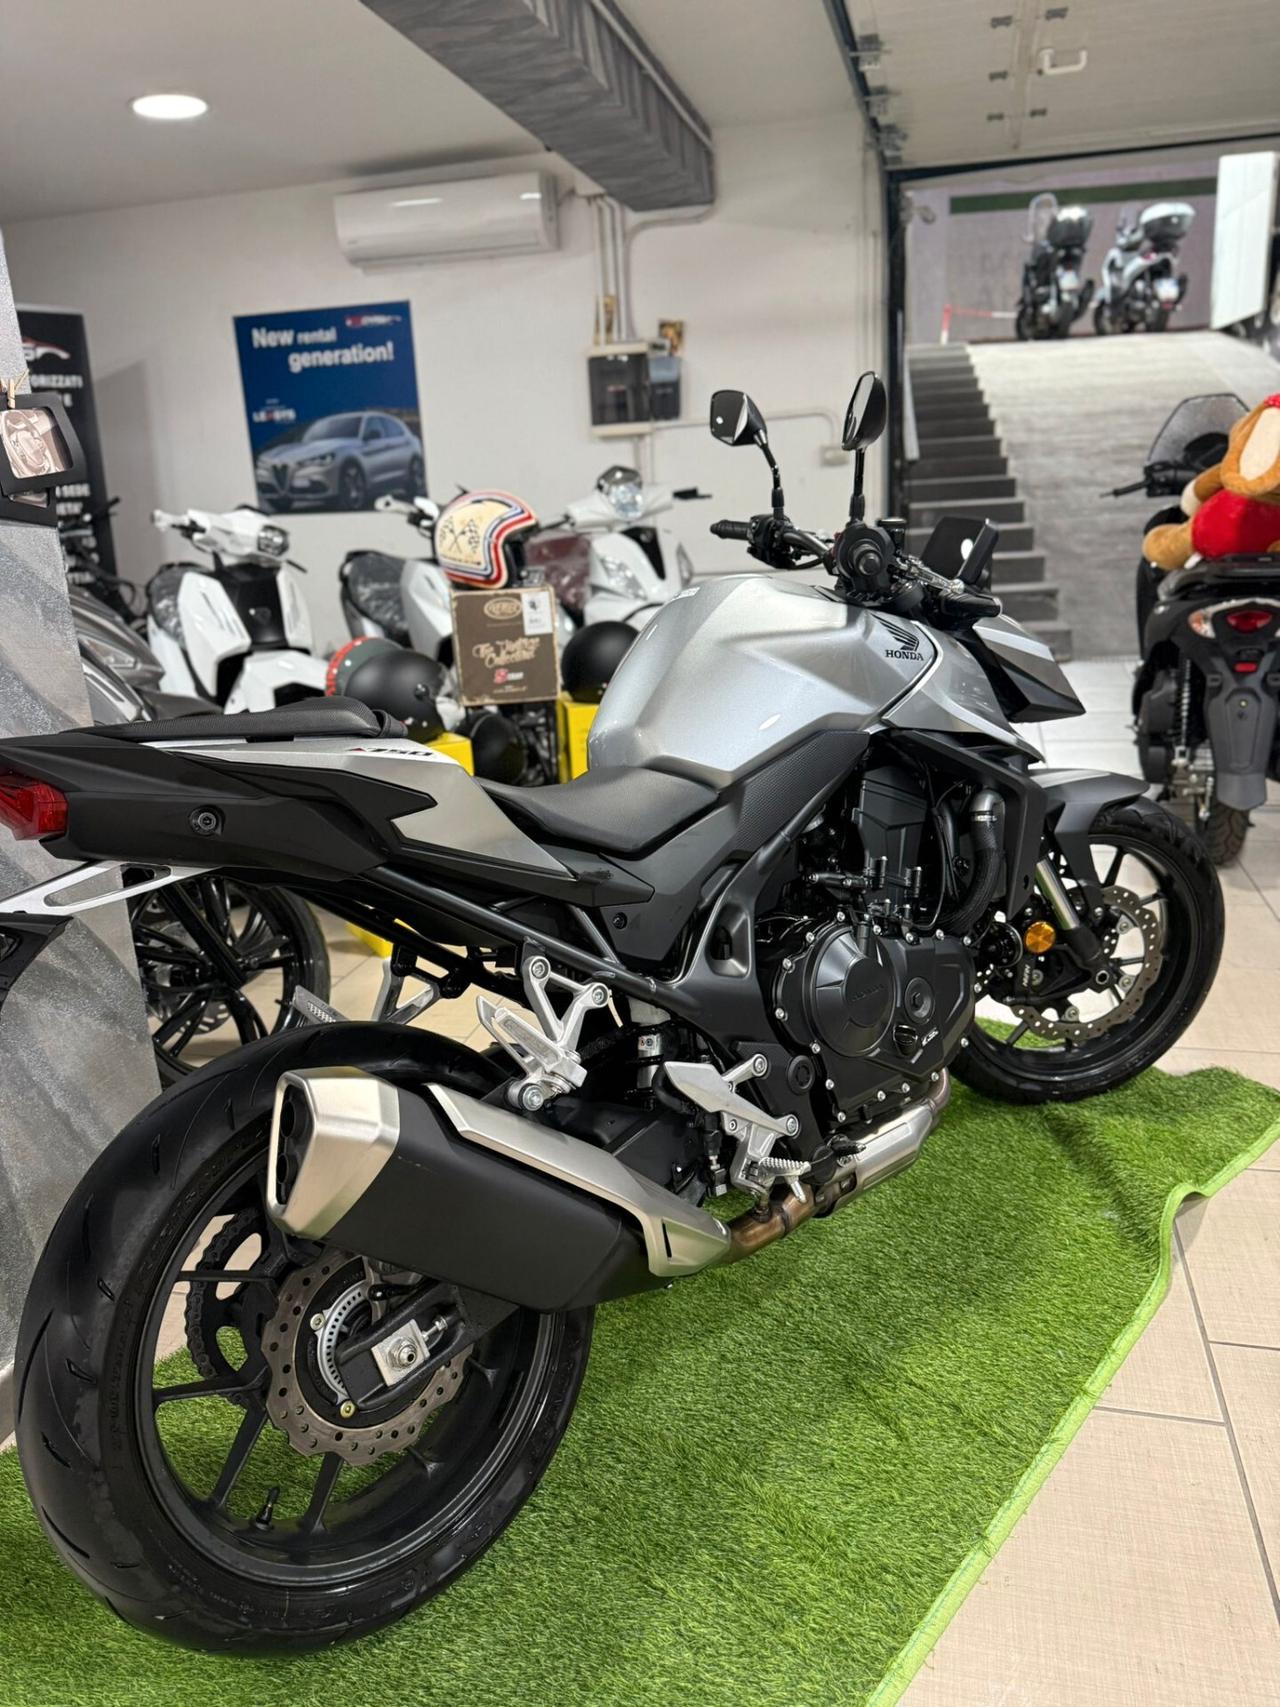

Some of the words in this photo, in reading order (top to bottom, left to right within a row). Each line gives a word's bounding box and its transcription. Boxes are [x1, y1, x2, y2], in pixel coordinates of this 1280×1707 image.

[251, 327, 295, 349] New
[297, 327, 338, 345] rental
[288, 341, 395, 374] generation!
[885, 649, 924, 661] HONDA
